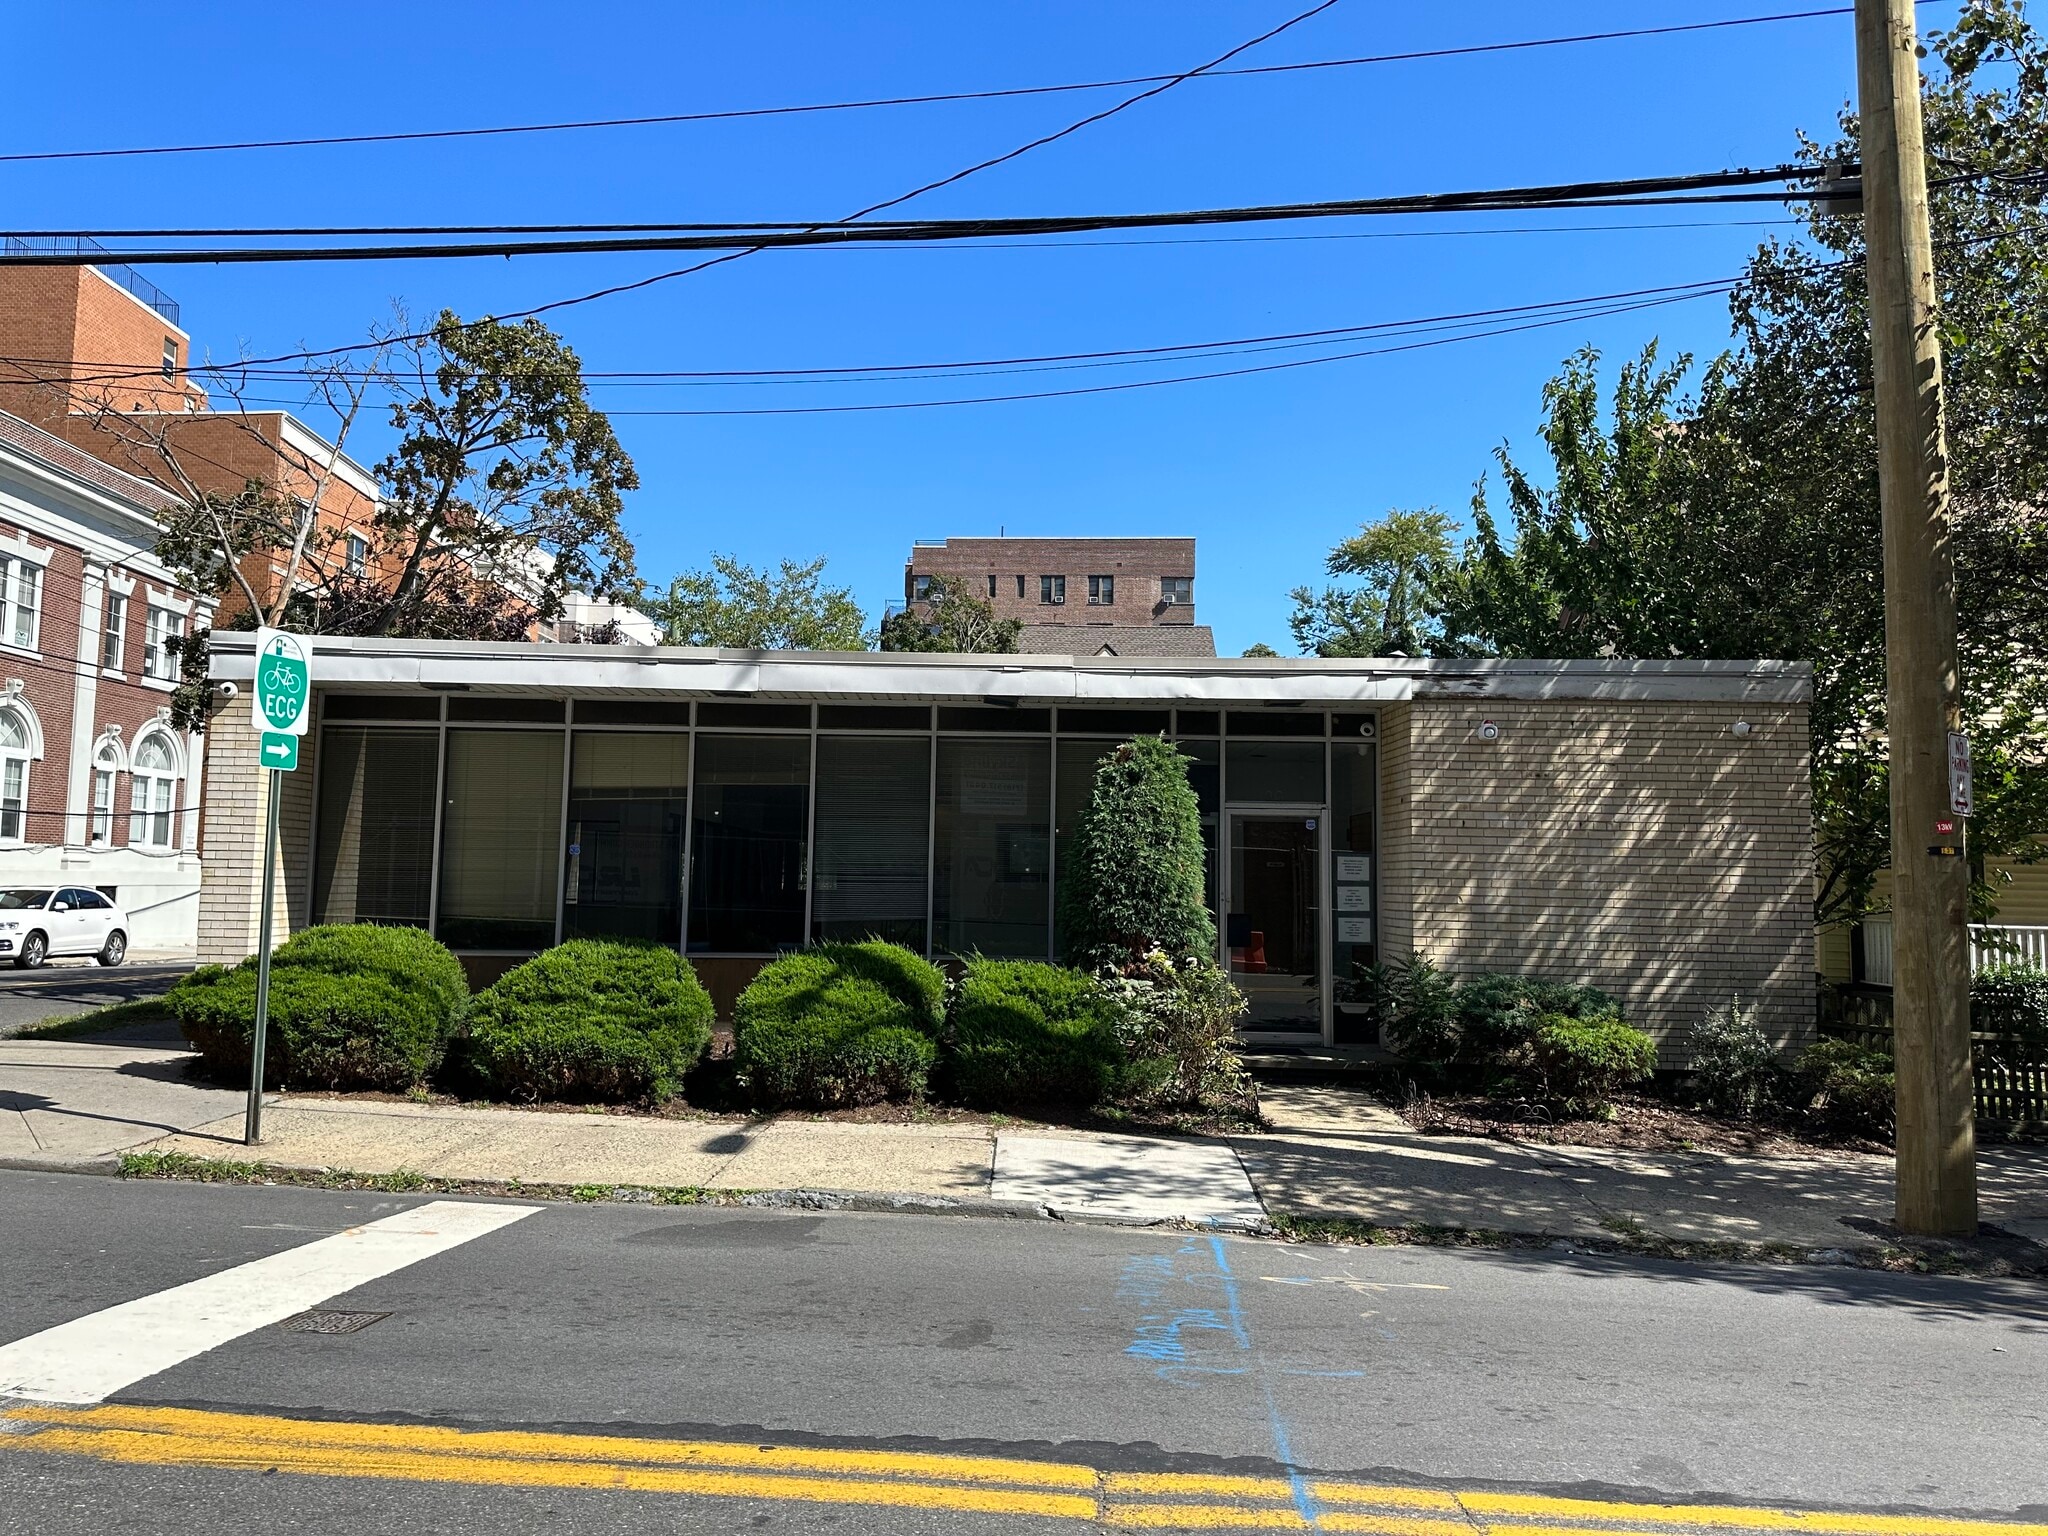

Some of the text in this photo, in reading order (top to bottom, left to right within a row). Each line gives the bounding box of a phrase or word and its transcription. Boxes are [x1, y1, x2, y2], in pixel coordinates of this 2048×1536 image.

[266, 693, 297, 719] ECG
[1955, 741, 1964, 756] NO
[1957, 785, 1966, 798] TME
[1937, 823, 1953, 831] 13kV
